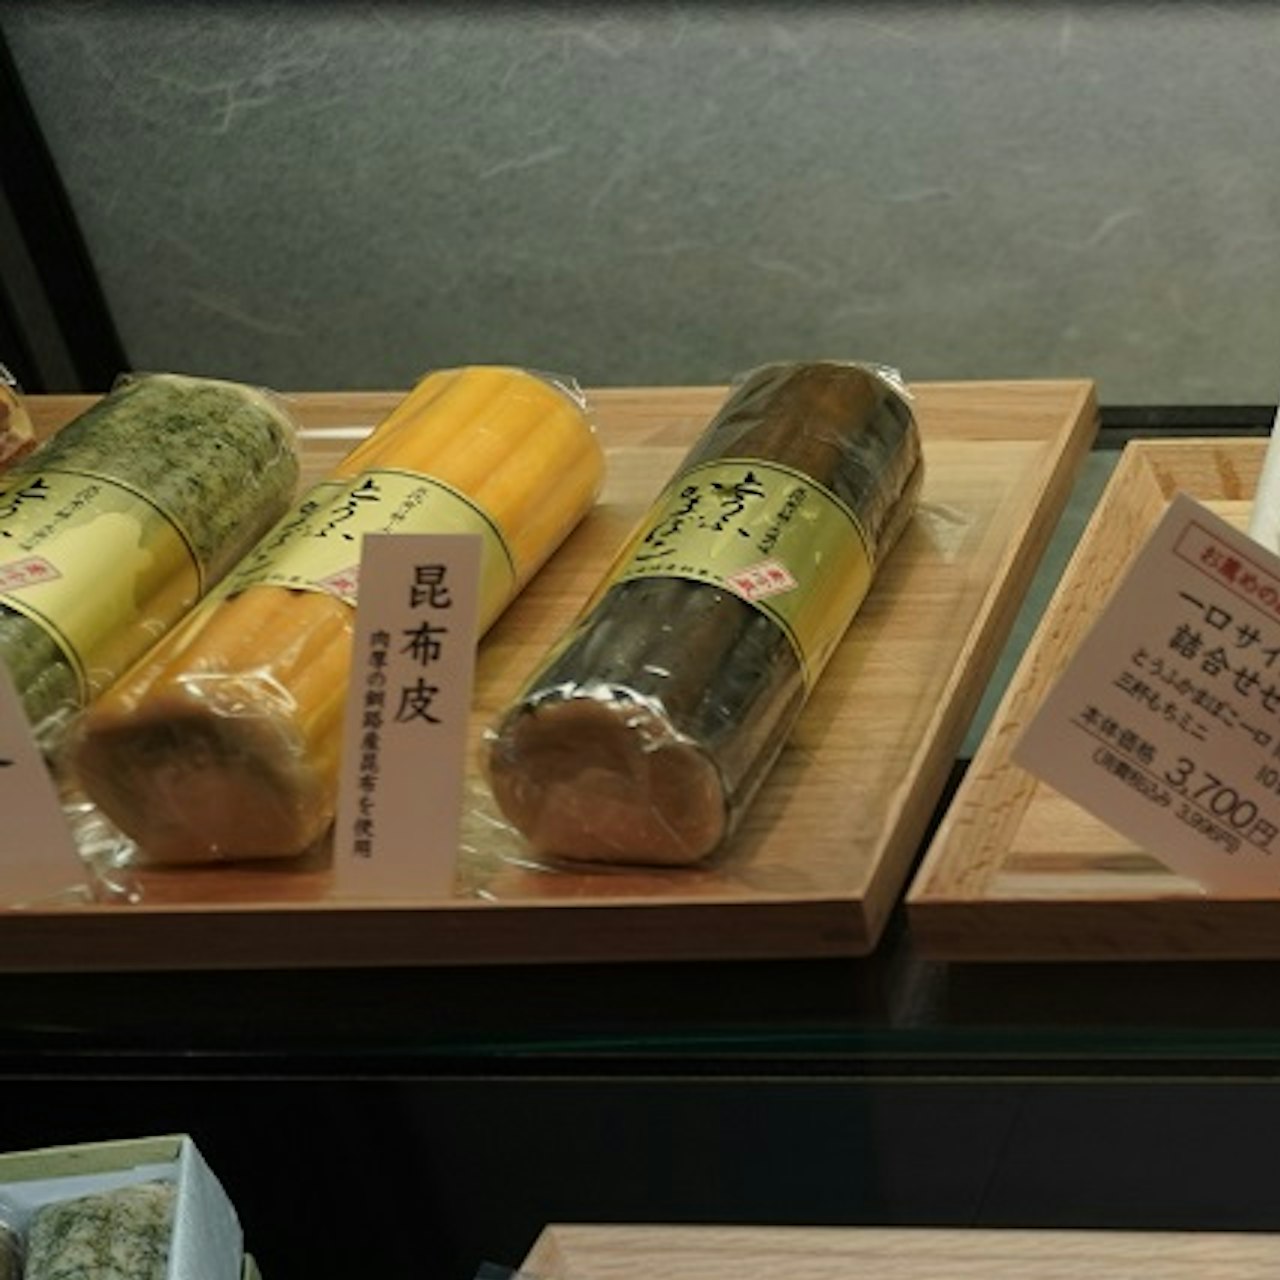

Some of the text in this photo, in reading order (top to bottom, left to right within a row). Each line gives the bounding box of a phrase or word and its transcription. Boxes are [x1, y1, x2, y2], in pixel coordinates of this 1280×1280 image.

[394, 564, 453, 724] 昆布皮
[1079, 706, 1280, 848] 本体価格 3,700円
